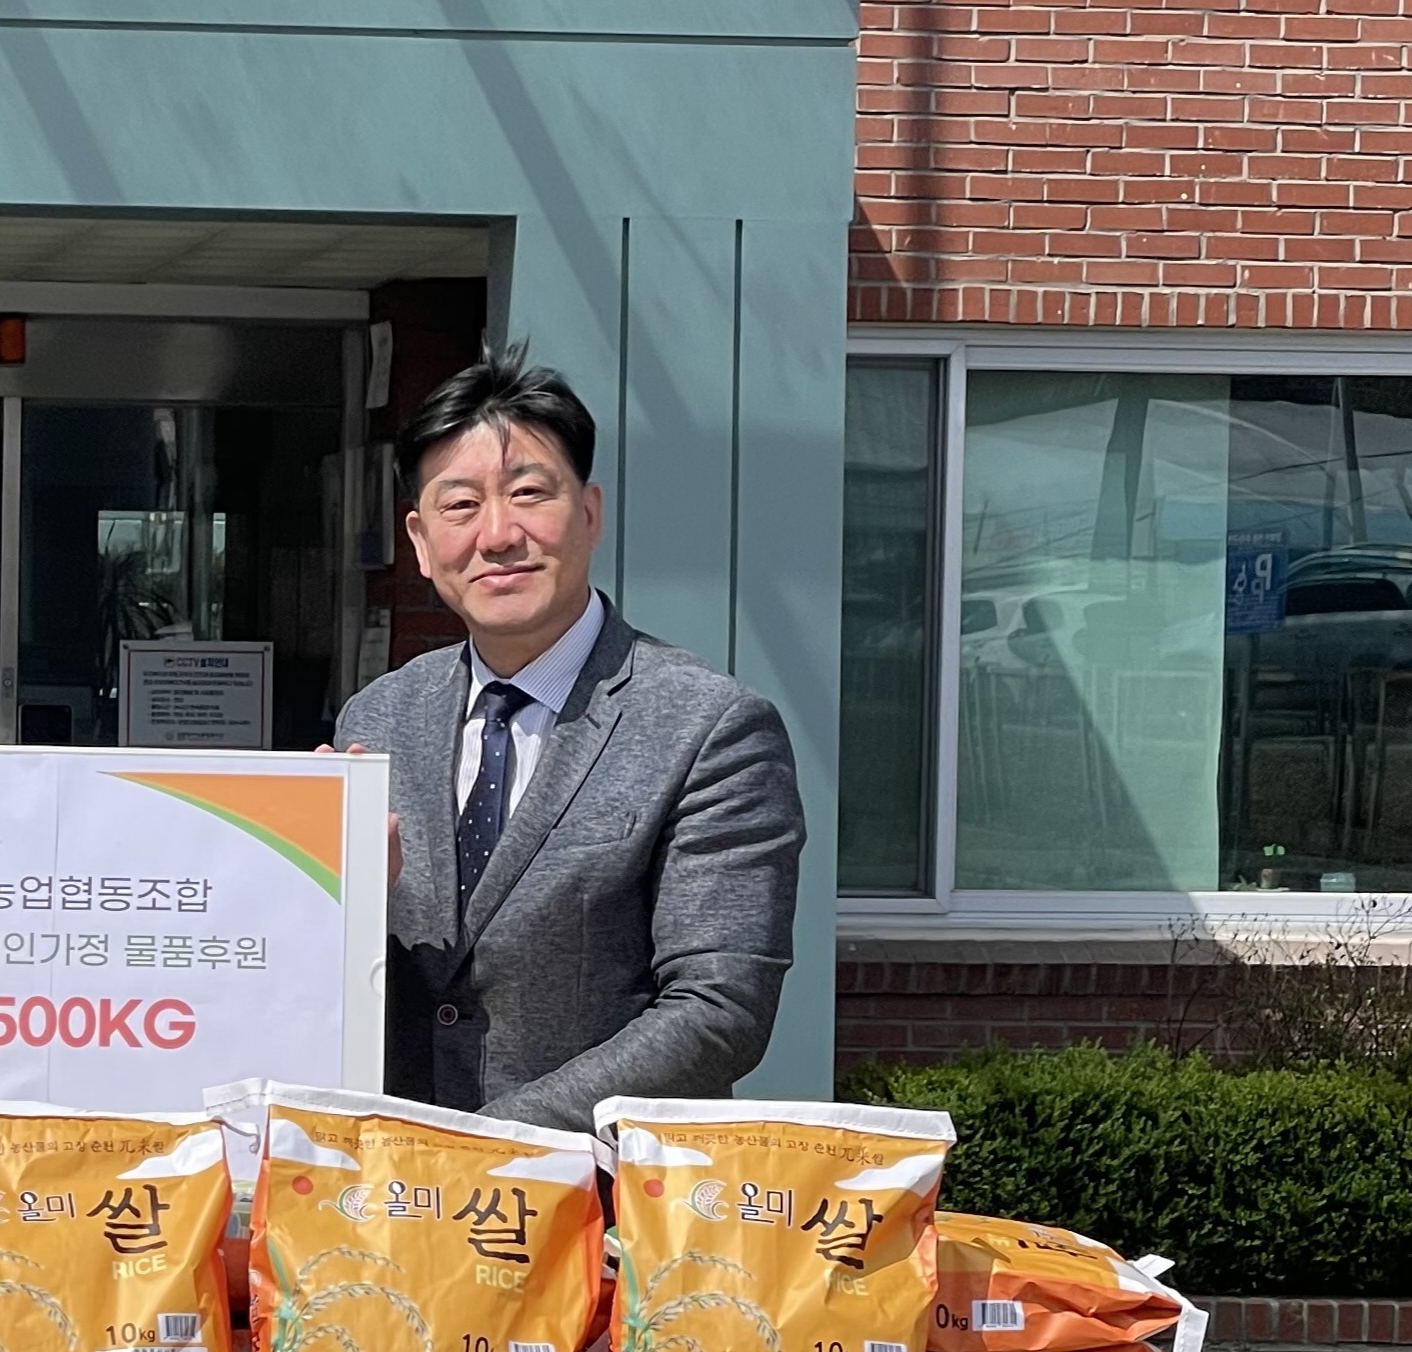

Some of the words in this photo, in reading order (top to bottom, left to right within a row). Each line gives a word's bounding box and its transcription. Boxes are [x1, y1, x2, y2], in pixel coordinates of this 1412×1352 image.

[124, 934, 268, 970] 물품후원
[17, 1191, 75, 1222] 올미
[87, 1184, 170, 1254] 쌀
[384, 1180, 441, 1220] 올미
[453, 1187, 537, 1263] 쌀
[737, 1182, 793, 1227] 올미
[800, 1198, 883, 1269] 쌀
[112, 1254, 167, 1279] RICE
[476, 1264, 527, 1293] RICE
[935, 1303, 968, 1329] 0kg
[106, 1322, 155, 1346] 10kg
